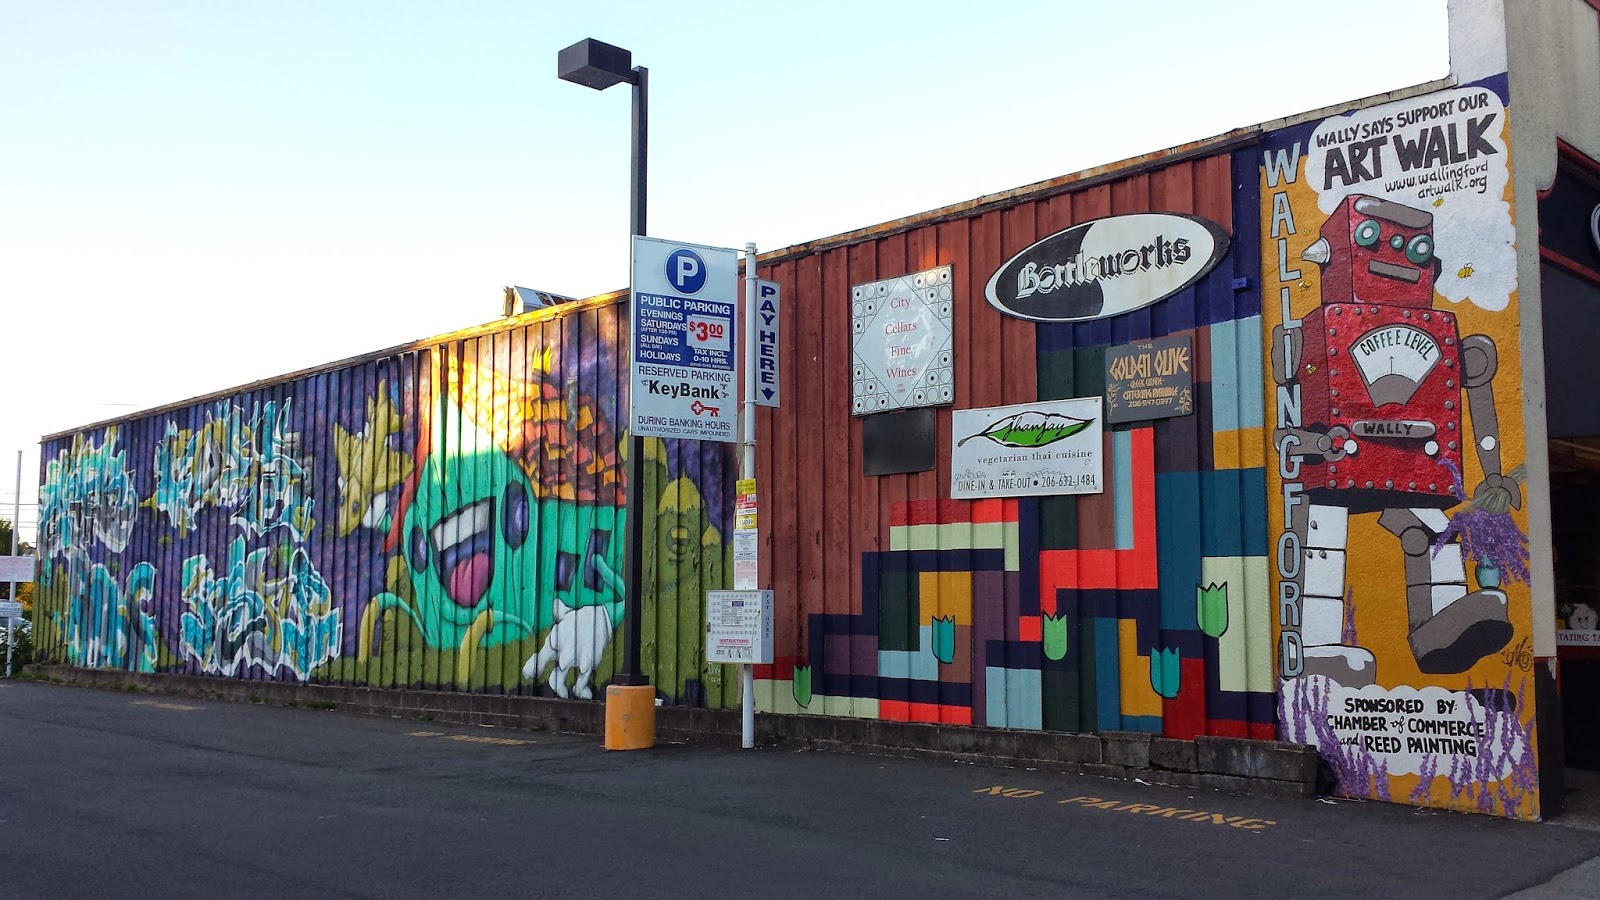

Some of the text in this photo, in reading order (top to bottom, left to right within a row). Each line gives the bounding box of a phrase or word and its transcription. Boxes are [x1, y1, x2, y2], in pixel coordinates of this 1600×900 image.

[1316, 92, 1489, 148] WALLY SAYS SUPPORT OUR
[1323, 113, 1499, 190] ART WALK
[1384, 160, 1488, 193] www.wallingford
[1418, 175, 1487, 199] artwalk.org
[677, 255, 699, 286] P
[1014, 234, 1192, 300] Bottleworks
[640, 295, 731, 315] PUBLIC PARKING
[890, 297, 911, 310] City
[640, 308, 684, 321] EVENINGS
[640, 318, 687, 332] SATURDAYS
[885, 321, 918, 335] Cellars
[640, 334, 679, 347] SUNDAYS
[1359, 329, 1435, 361] COFFEE LEVEL
[640, 350, 681, 362] HOLIDAYS
[693, 355, 728, 365] 0-10 HRS.
[890, 345, 911, 357] Fine
[1109, 347, 1189, 380] GOLDEN OLIVE
[638, 365, 731, 383] RESERVED PARKING
[886, 367, 917, 379] Wines
[648, 380, 720, 400] KeyBank
[1122, 388, 1152, 400] CATERING
[638, 415, 731, 430] DURING BANKING HOURS
[638, 426, 681, 434] UNAUTHORIZED
[1363, 422, 1413, 436] WALLY
[977, 450, 1093, 465] vegetarian thai cuisine
[958, 474, 1096, 492] DINE-IN & TAKE-OUT 206-632-1484
[1344, 697, 1458, 715] SPONSORED BY:
[1326, 714, 1486, 738] CHAMBER of COMMERCE
[1339, 732, 1477, 758] and REED PAINTING
[972, 785, 1278, 829] NO PARKING
